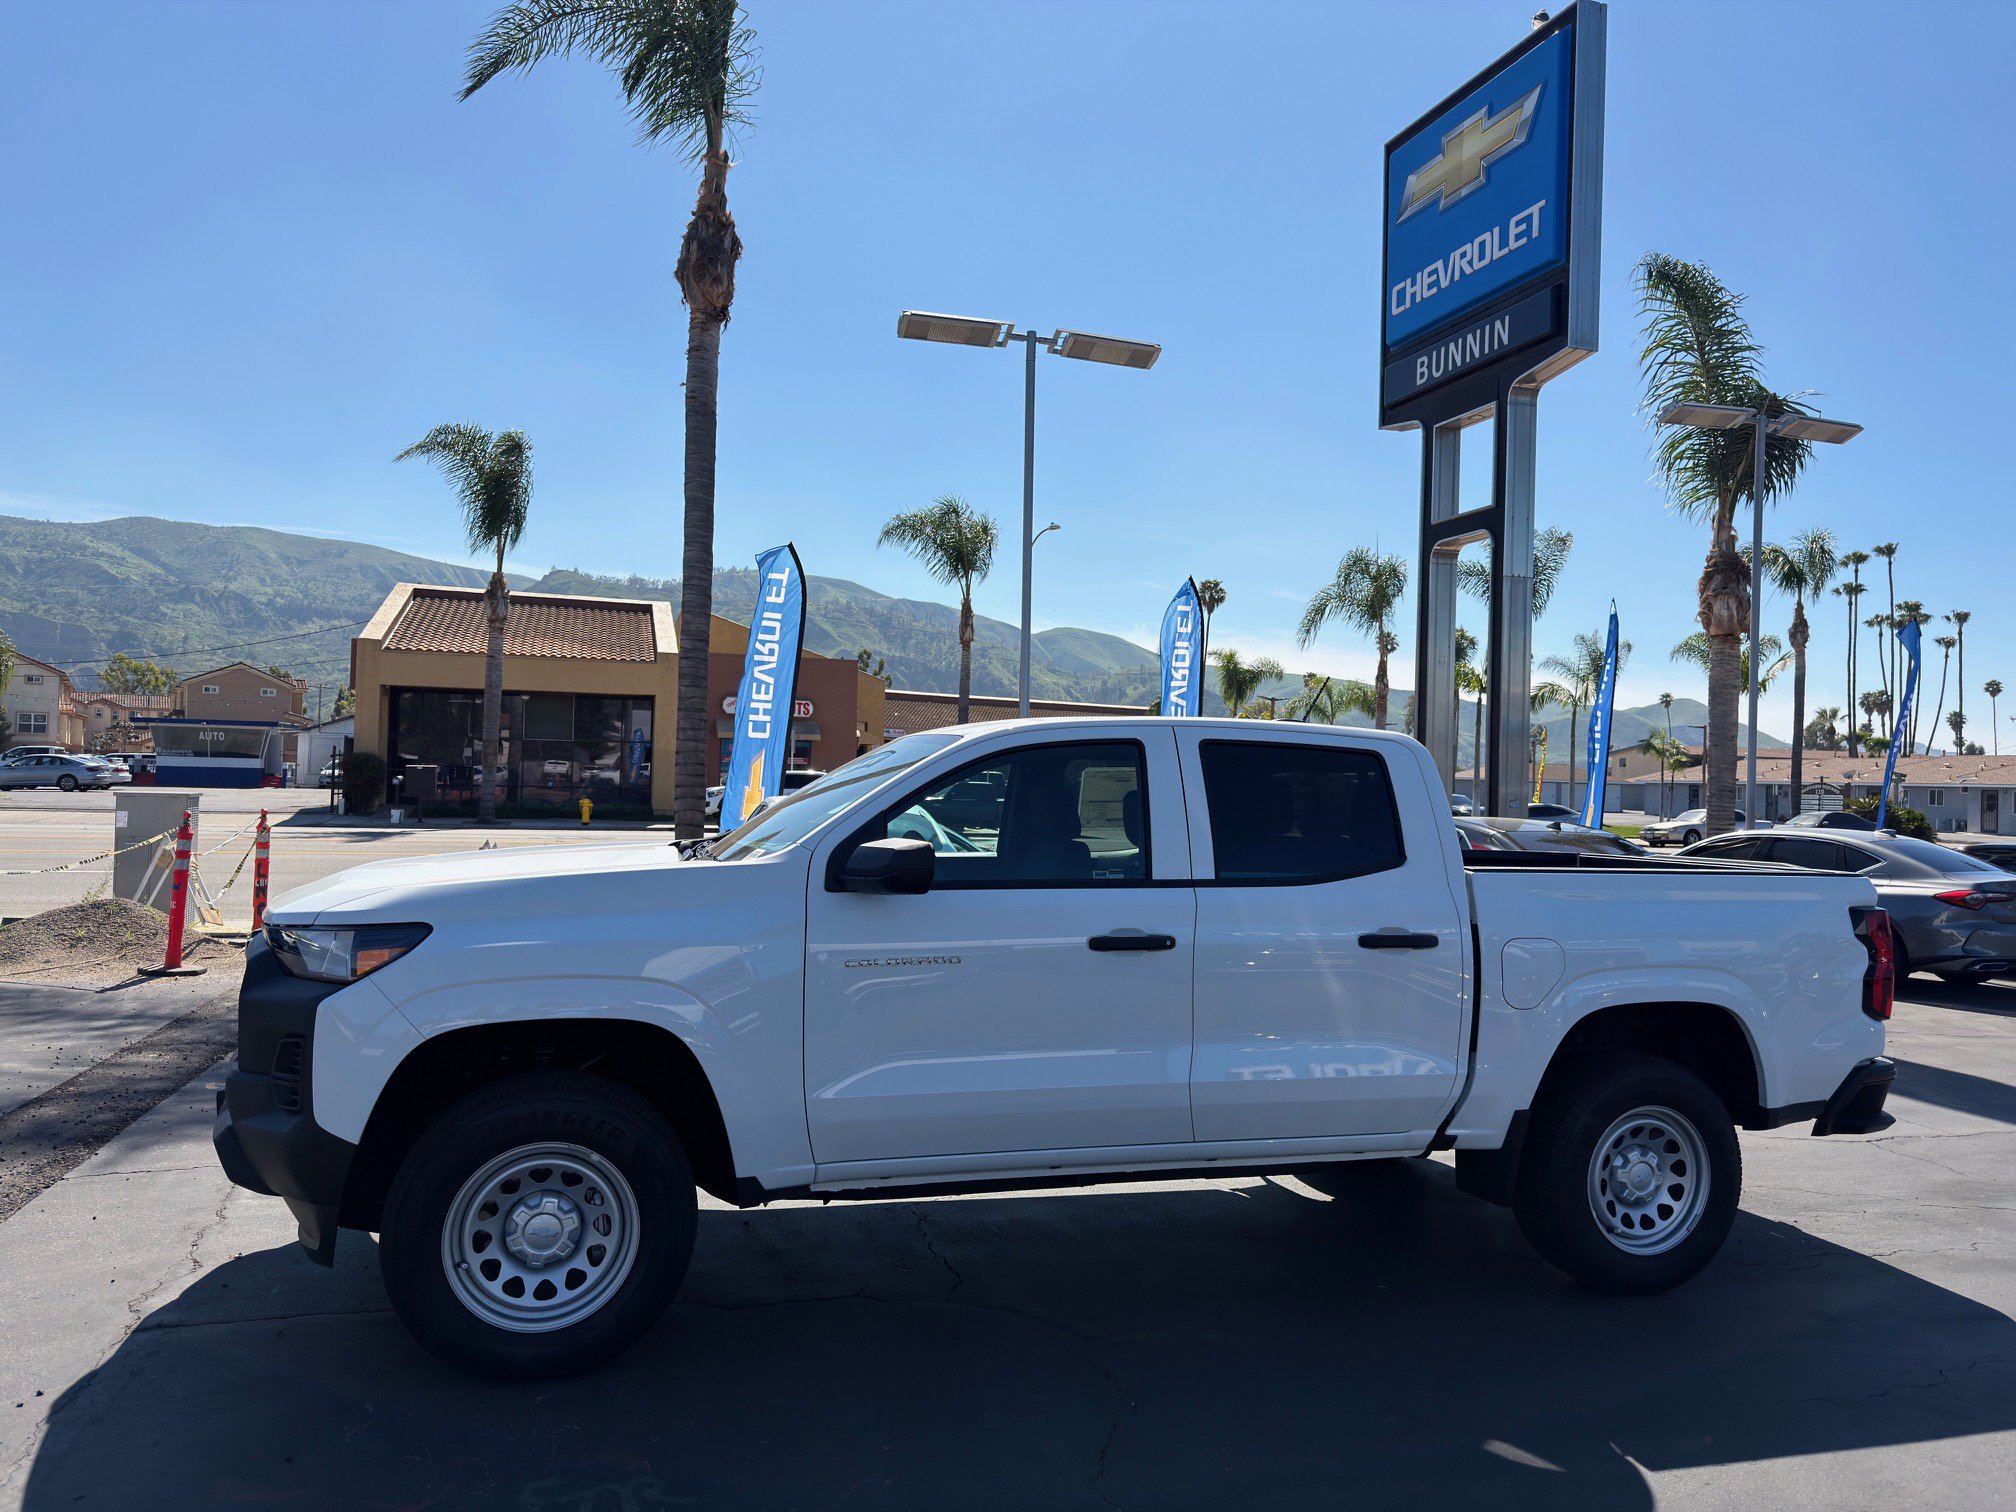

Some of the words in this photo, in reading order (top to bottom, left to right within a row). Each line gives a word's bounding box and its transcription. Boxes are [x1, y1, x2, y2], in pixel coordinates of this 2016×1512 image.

[1391, 199, 1548, 316] CHEVROLET
[1416, 314, 1511, 386] BUNNIN
[199, 731, 225, 740] AUTO
[844, 956, 962, 967] COLORADO
